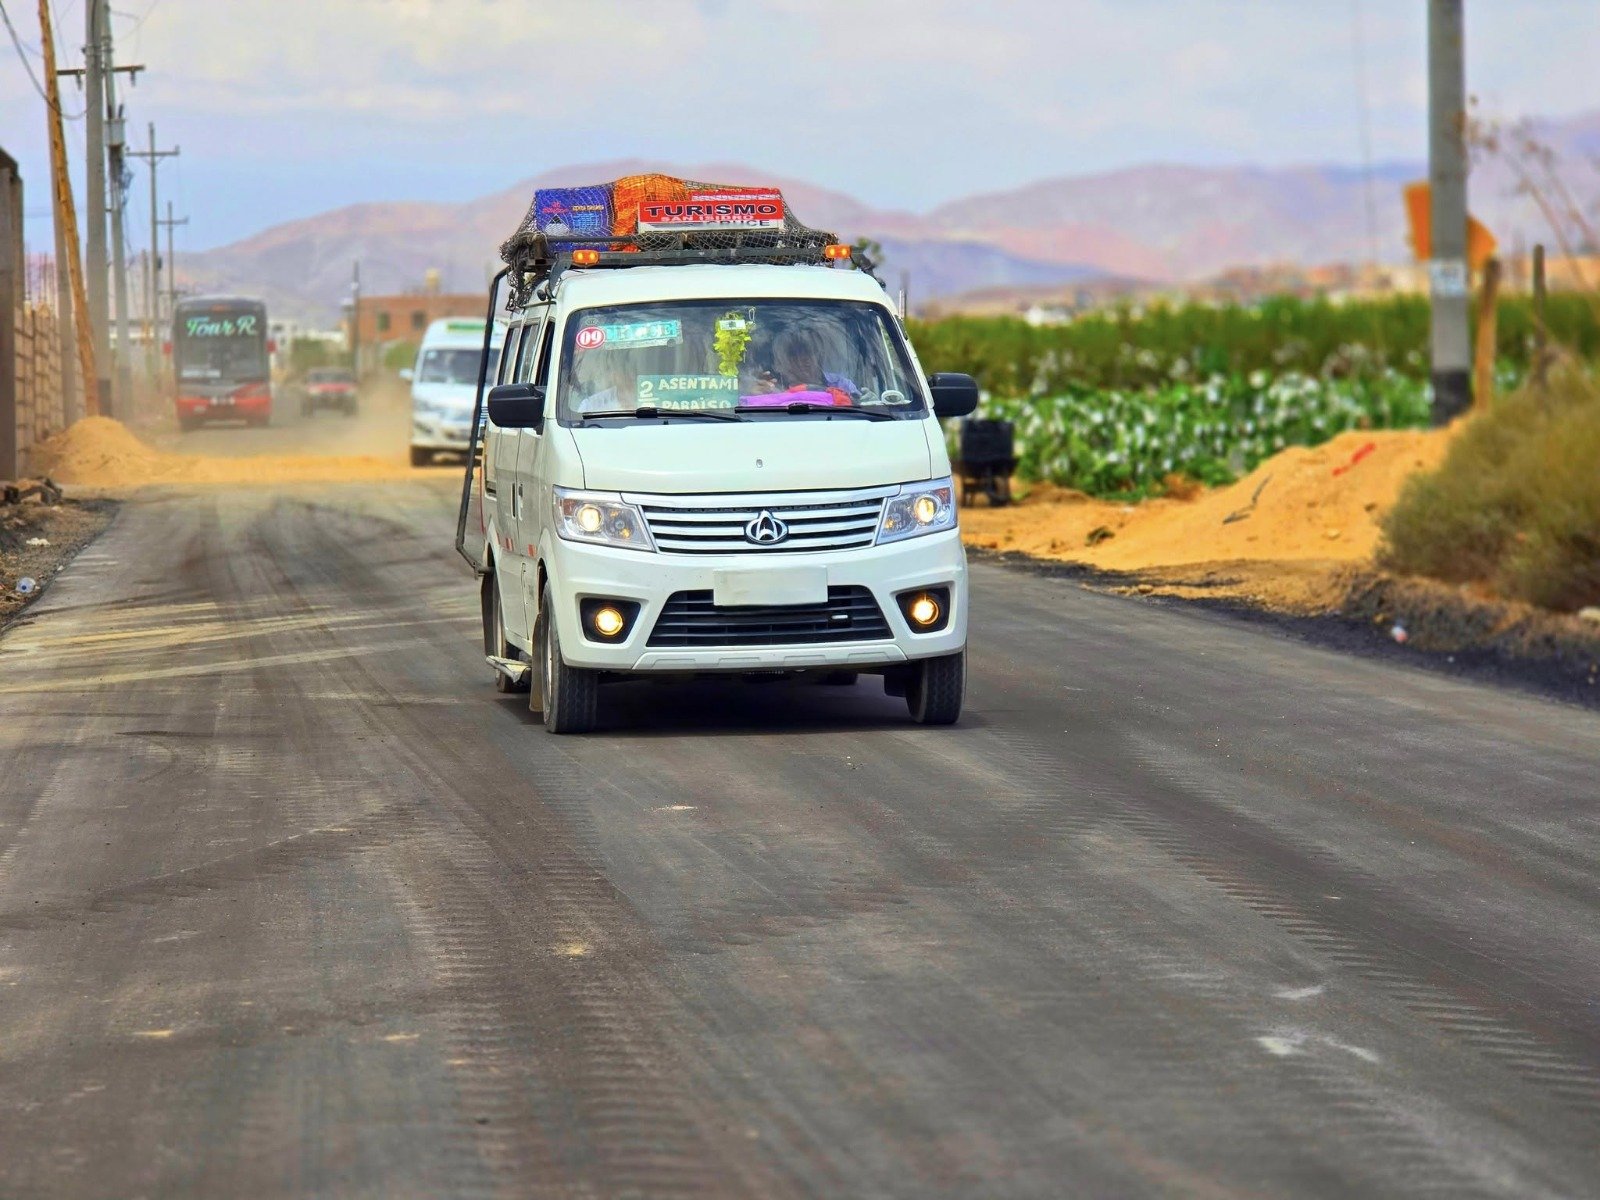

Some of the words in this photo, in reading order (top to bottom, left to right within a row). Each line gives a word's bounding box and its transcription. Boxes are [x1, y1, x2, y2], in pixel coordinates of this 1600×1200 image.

[645, 204, 777, 216] TURISMO
[580, 330, 602, 346] 09
[640, 381, 654, 398] 2
[658, 377, 739, 391] ASENTAMI
